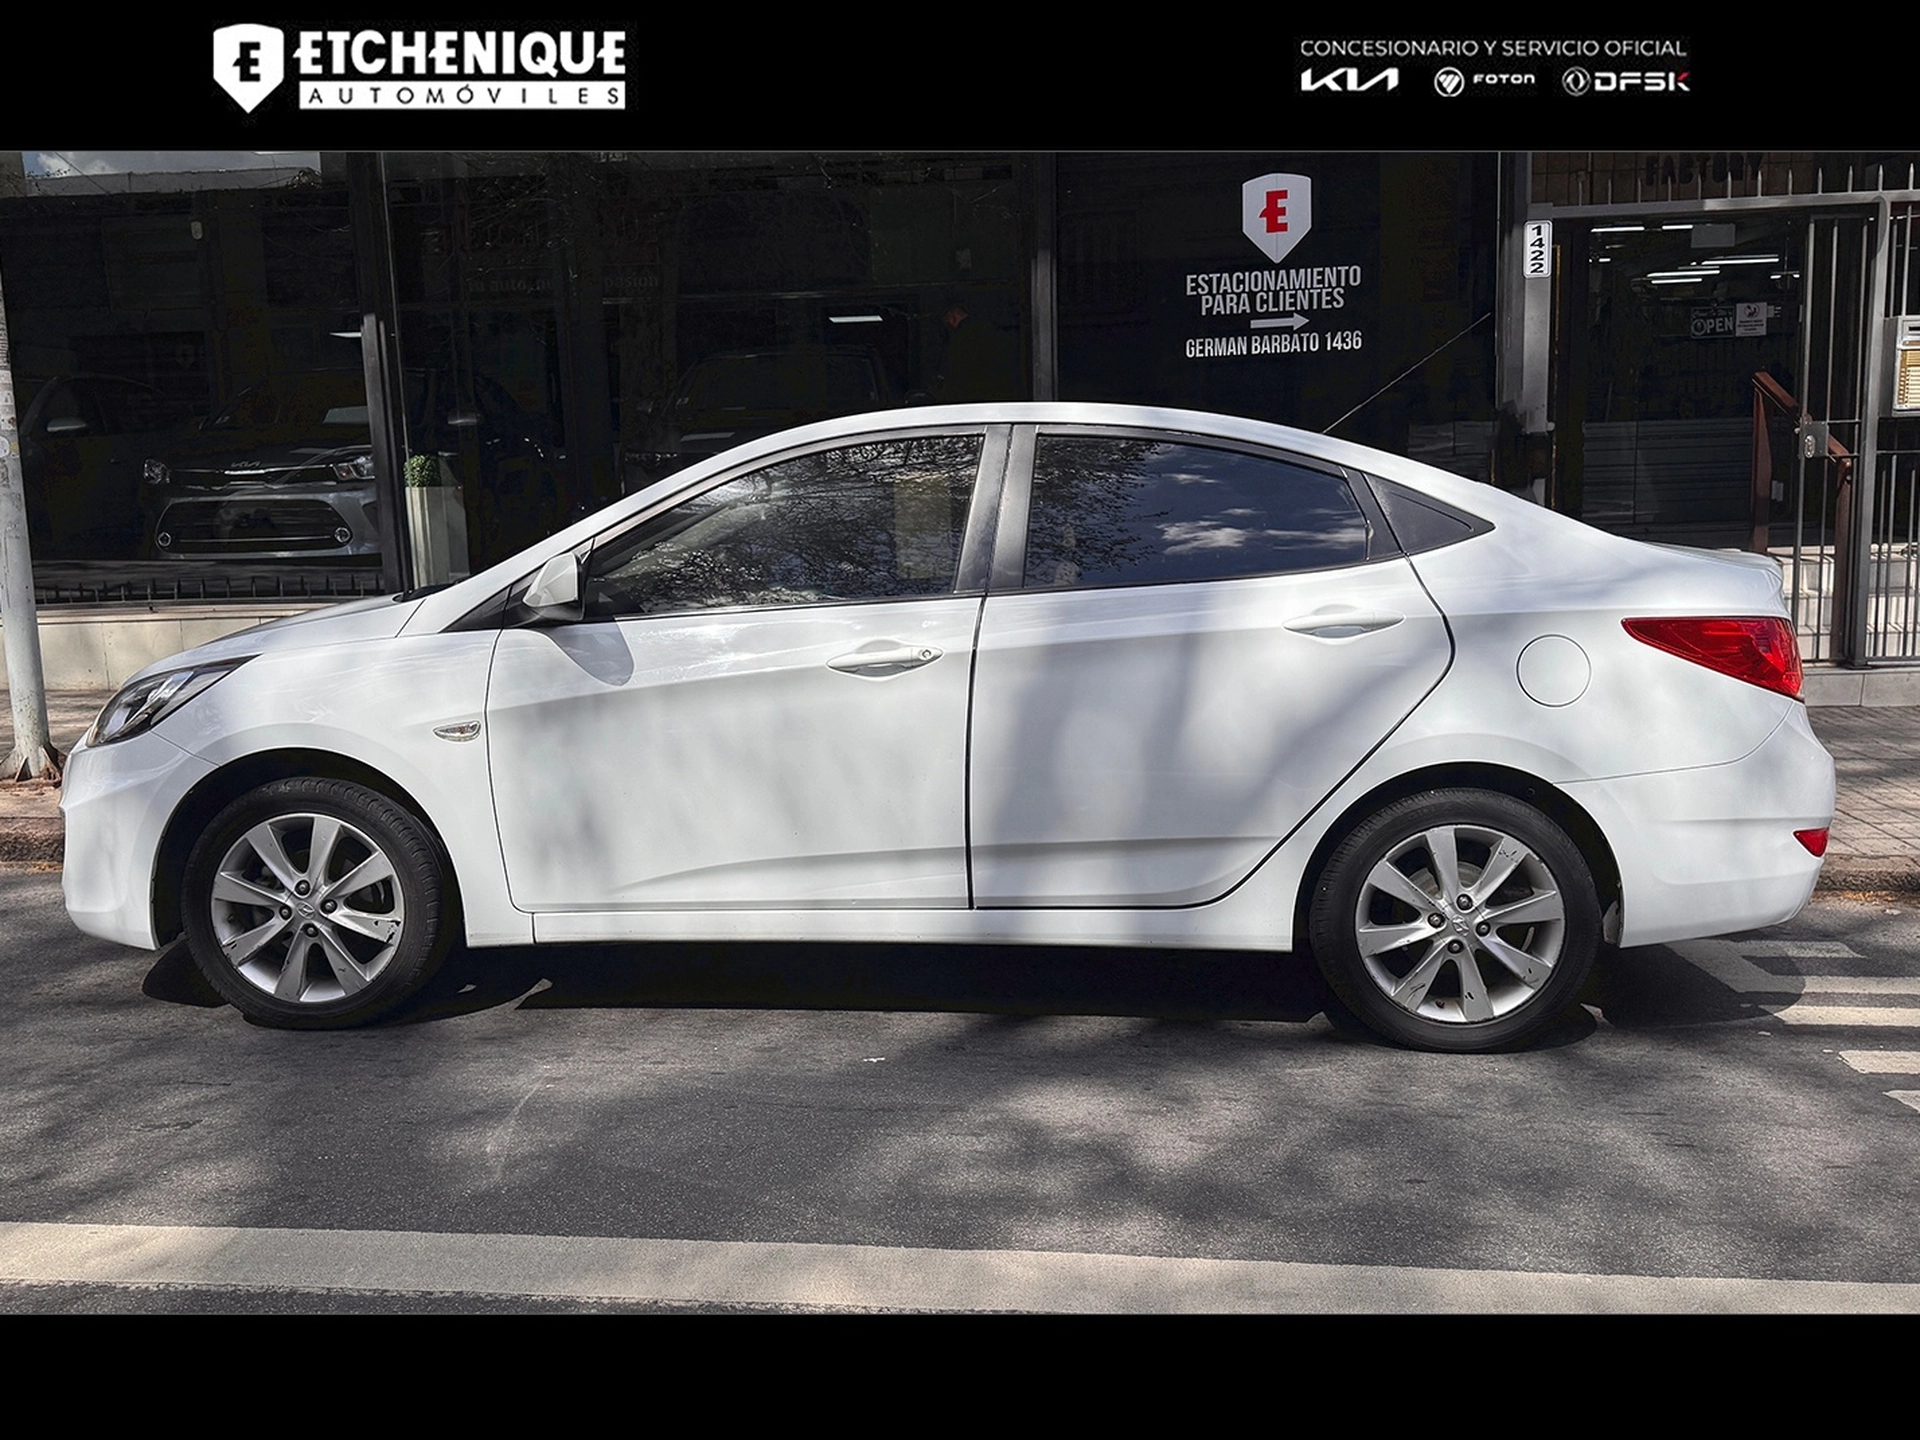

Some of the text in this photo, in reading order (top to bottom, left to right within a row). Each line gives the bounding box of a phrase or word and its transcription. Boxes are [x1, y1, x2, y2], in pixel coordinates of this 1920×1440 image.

[1530, 225, 1545, 274] 1422
[1186, 265, 1362, 296] ESTACIONAMIENTO
[1201, 287, 1345, 316] PARA CLIENTES
[1691, 316, 1733, 336] OPEN
[1186, 330, 1363, 359] GERMAN BARBATO 1436
